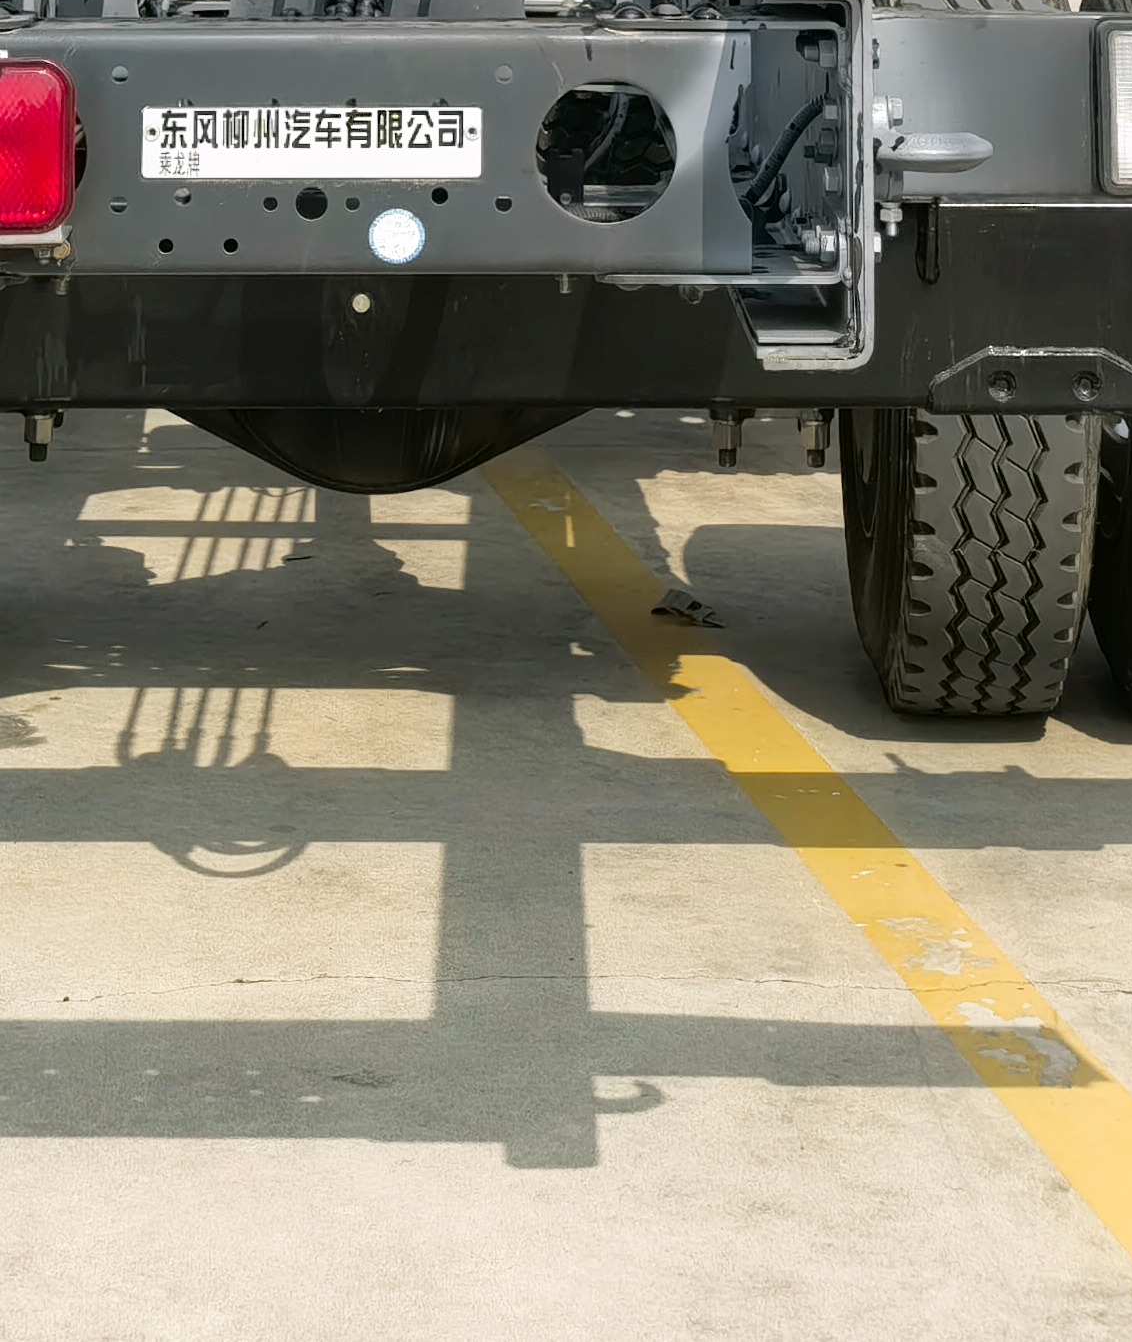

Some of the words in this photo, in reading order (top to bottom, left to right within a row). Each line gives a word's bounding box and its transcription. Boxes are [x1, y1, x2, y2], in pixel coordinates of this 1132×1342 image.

[160, 109, 464, 149] 东风柳州汽车有限公司
[159, 151, 200, 176] 乘龙牌
